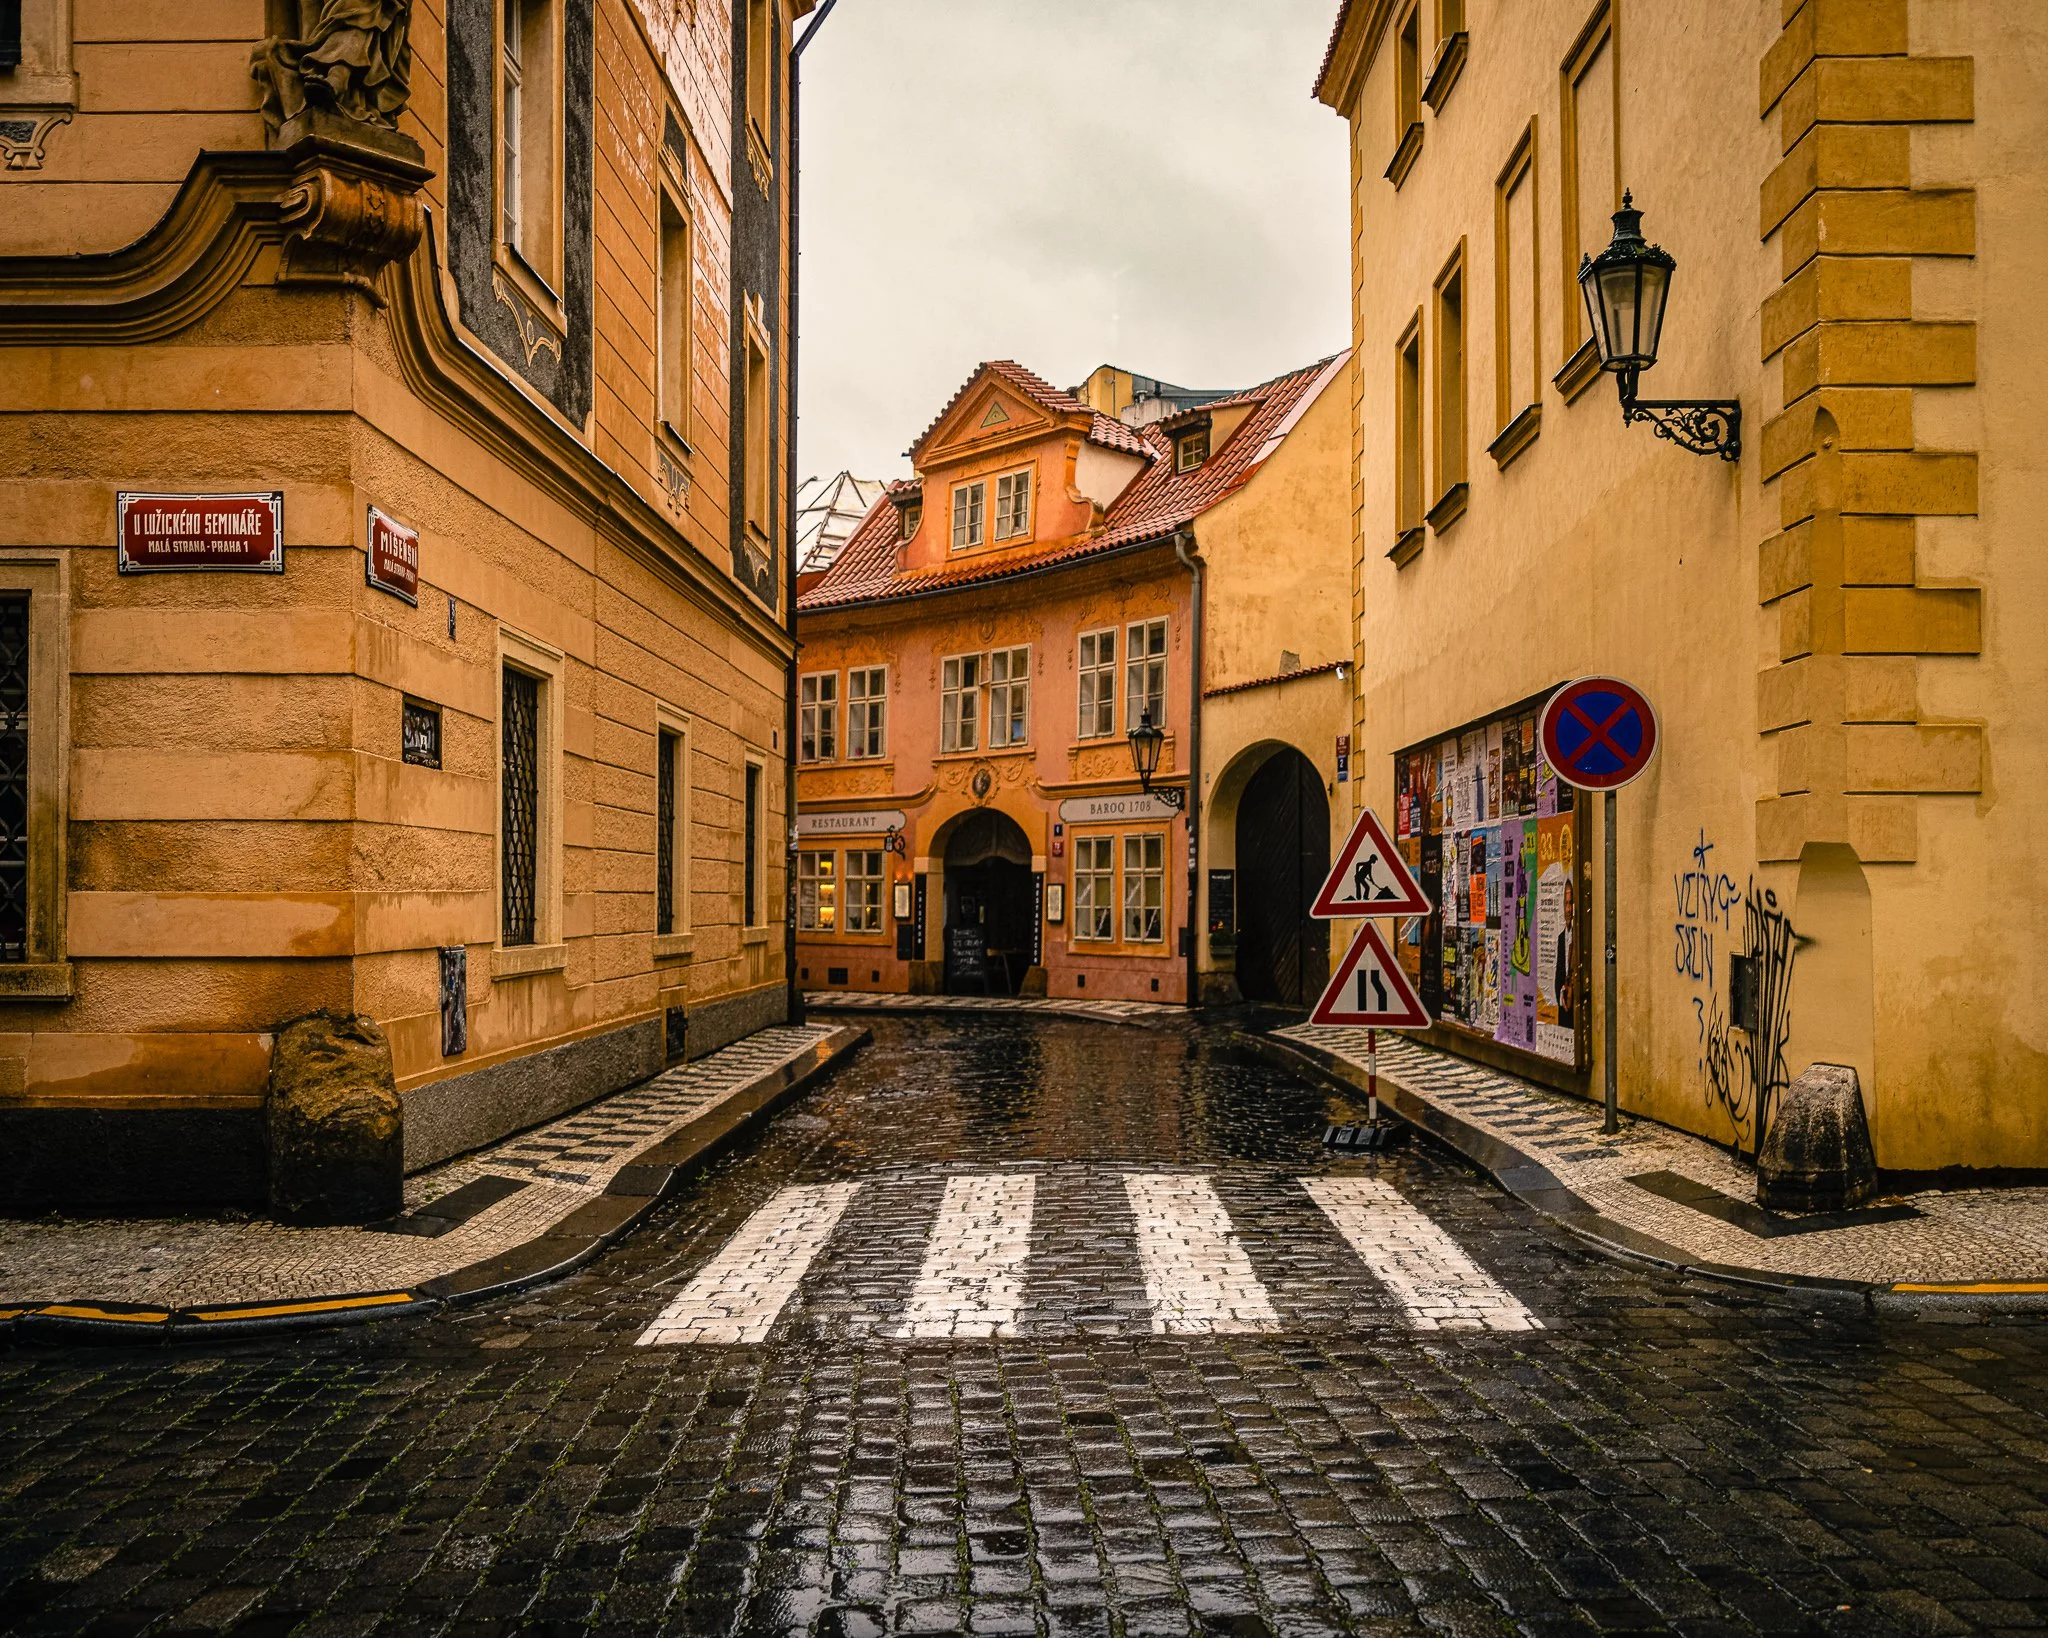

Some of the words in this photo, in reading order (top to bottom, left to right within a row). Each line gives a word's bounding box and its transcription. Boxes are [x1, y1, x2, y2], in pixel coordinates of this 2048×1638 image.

[133, 514, 141, 535] U
[144, 508, 201, 535] LUŽICKÉHO
[204, 508, 262, 536] SEMINÁŘE
[148, 538, 171, 553] MALÁ
[243, 541, 249, 553] 1
[1090, 801, 1126, 815] BAROQ
[1129, 800, 1152, 813] 1708
[811, 816, 876, 829] RESTAURANT
